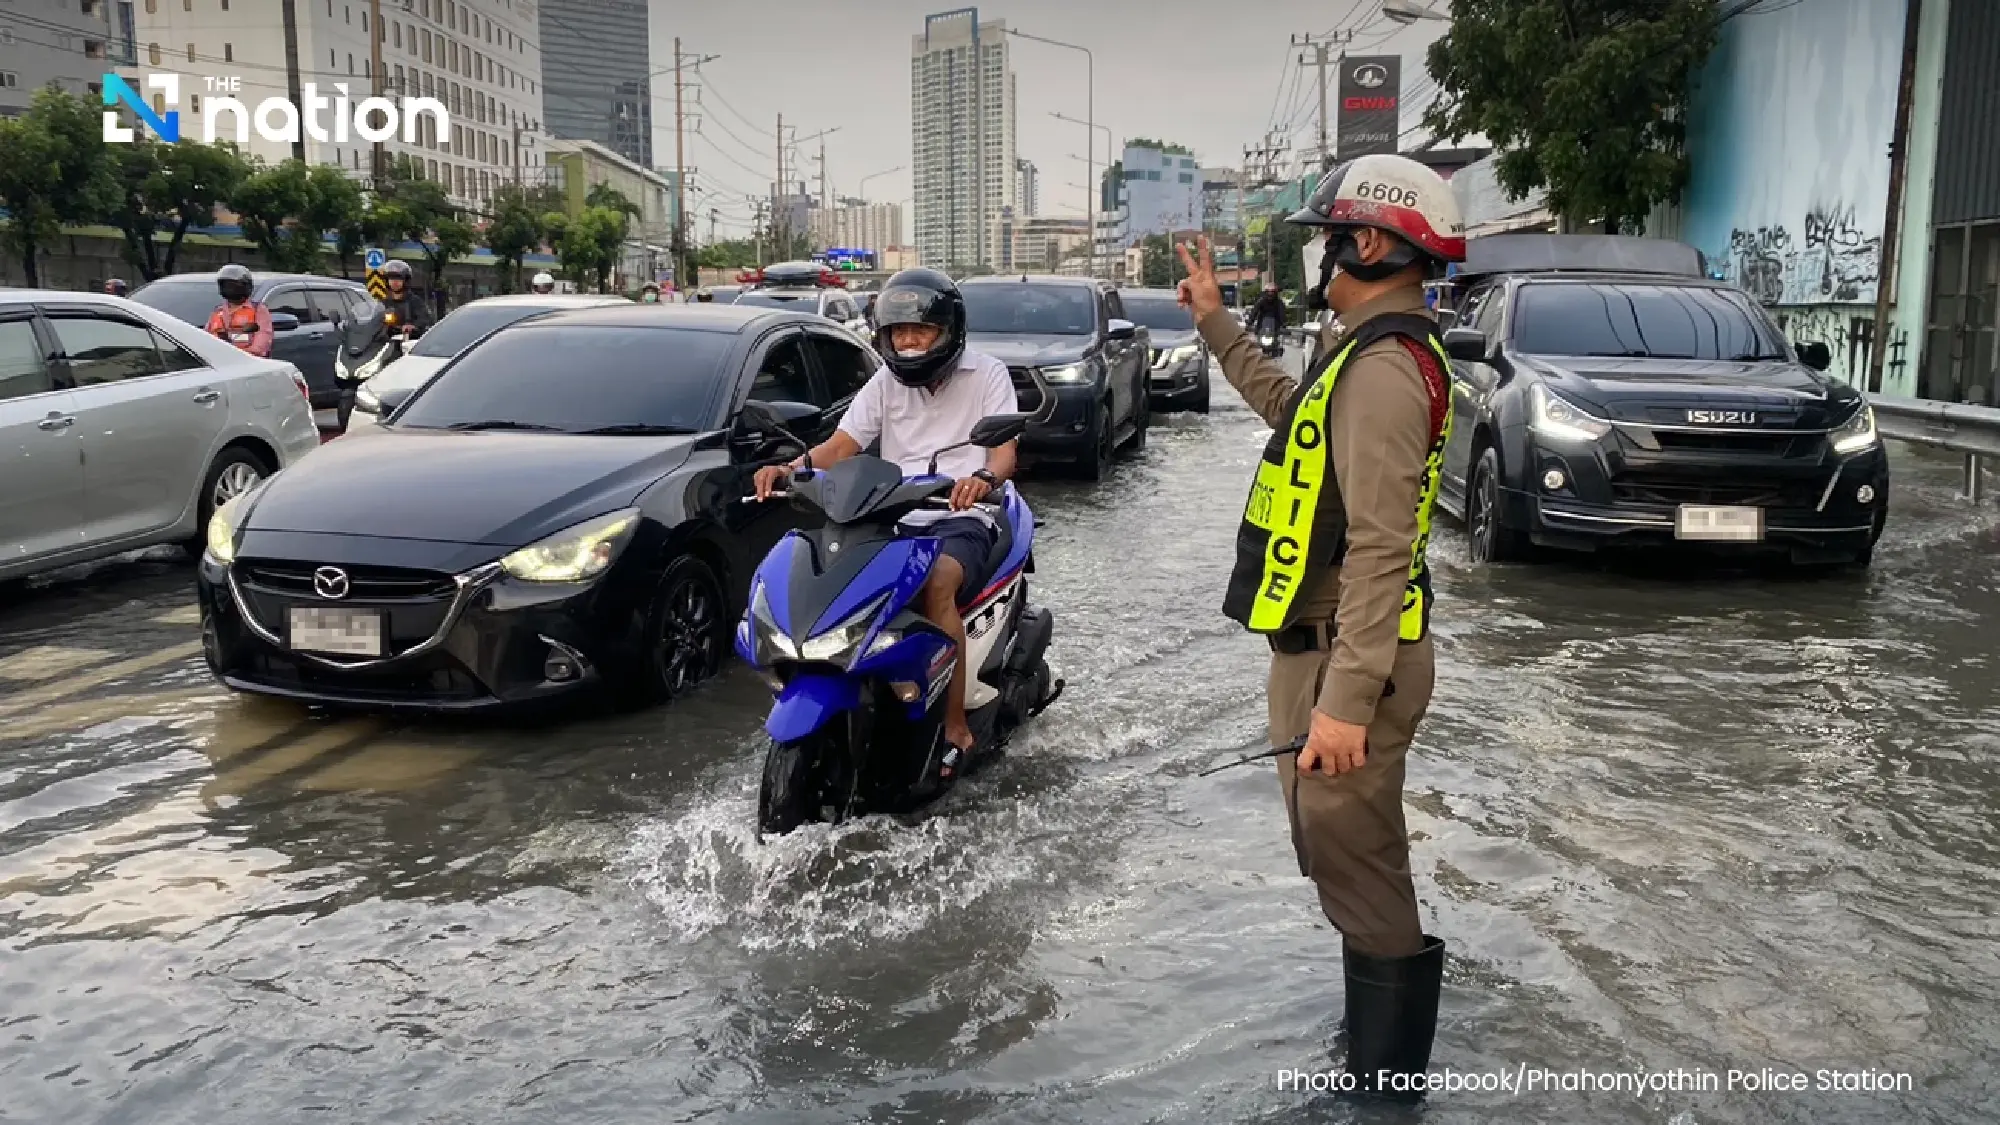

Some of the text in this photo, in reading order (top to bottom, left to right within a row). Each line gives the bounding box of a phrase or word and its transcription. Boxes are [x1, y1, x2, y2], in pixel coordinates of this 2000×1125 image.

[1344, 96, 1397, 109] GWM
[1357, 181, 1418, 208] 6606
[1688, 411, 1755, 424] ISUZU
[1264, 381, 1326, 603] POLICE
